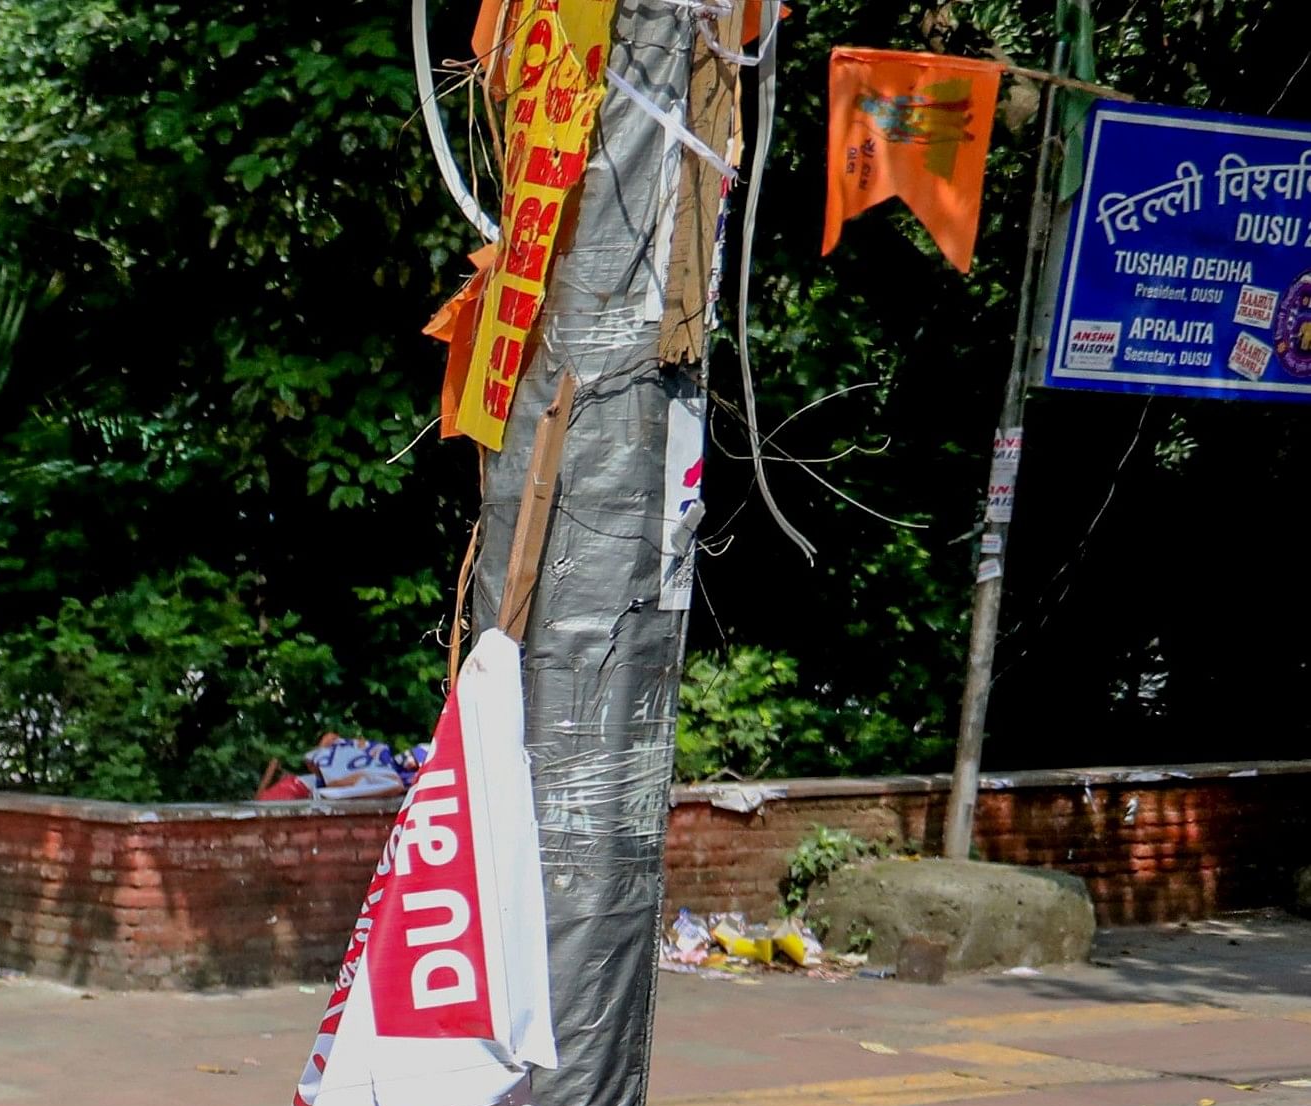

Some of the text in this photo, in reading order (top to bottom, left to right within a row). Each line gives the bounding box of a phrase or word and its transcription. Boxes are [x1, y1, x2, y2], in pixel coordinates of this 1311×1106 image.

[1096, 161, 1204, 245] दिल्ली
[1235, 212, 1301, 247] DUSU
[1115, 250, 1253, 283] TUSHAR DEDHA
[1135, 283, 1224, 304] President, DUSU
[1129, 317, 1214, 345] APRAJITA
[1179, 351, 1212, 367] DUSU
[403, 891, 478, 1011] DU
